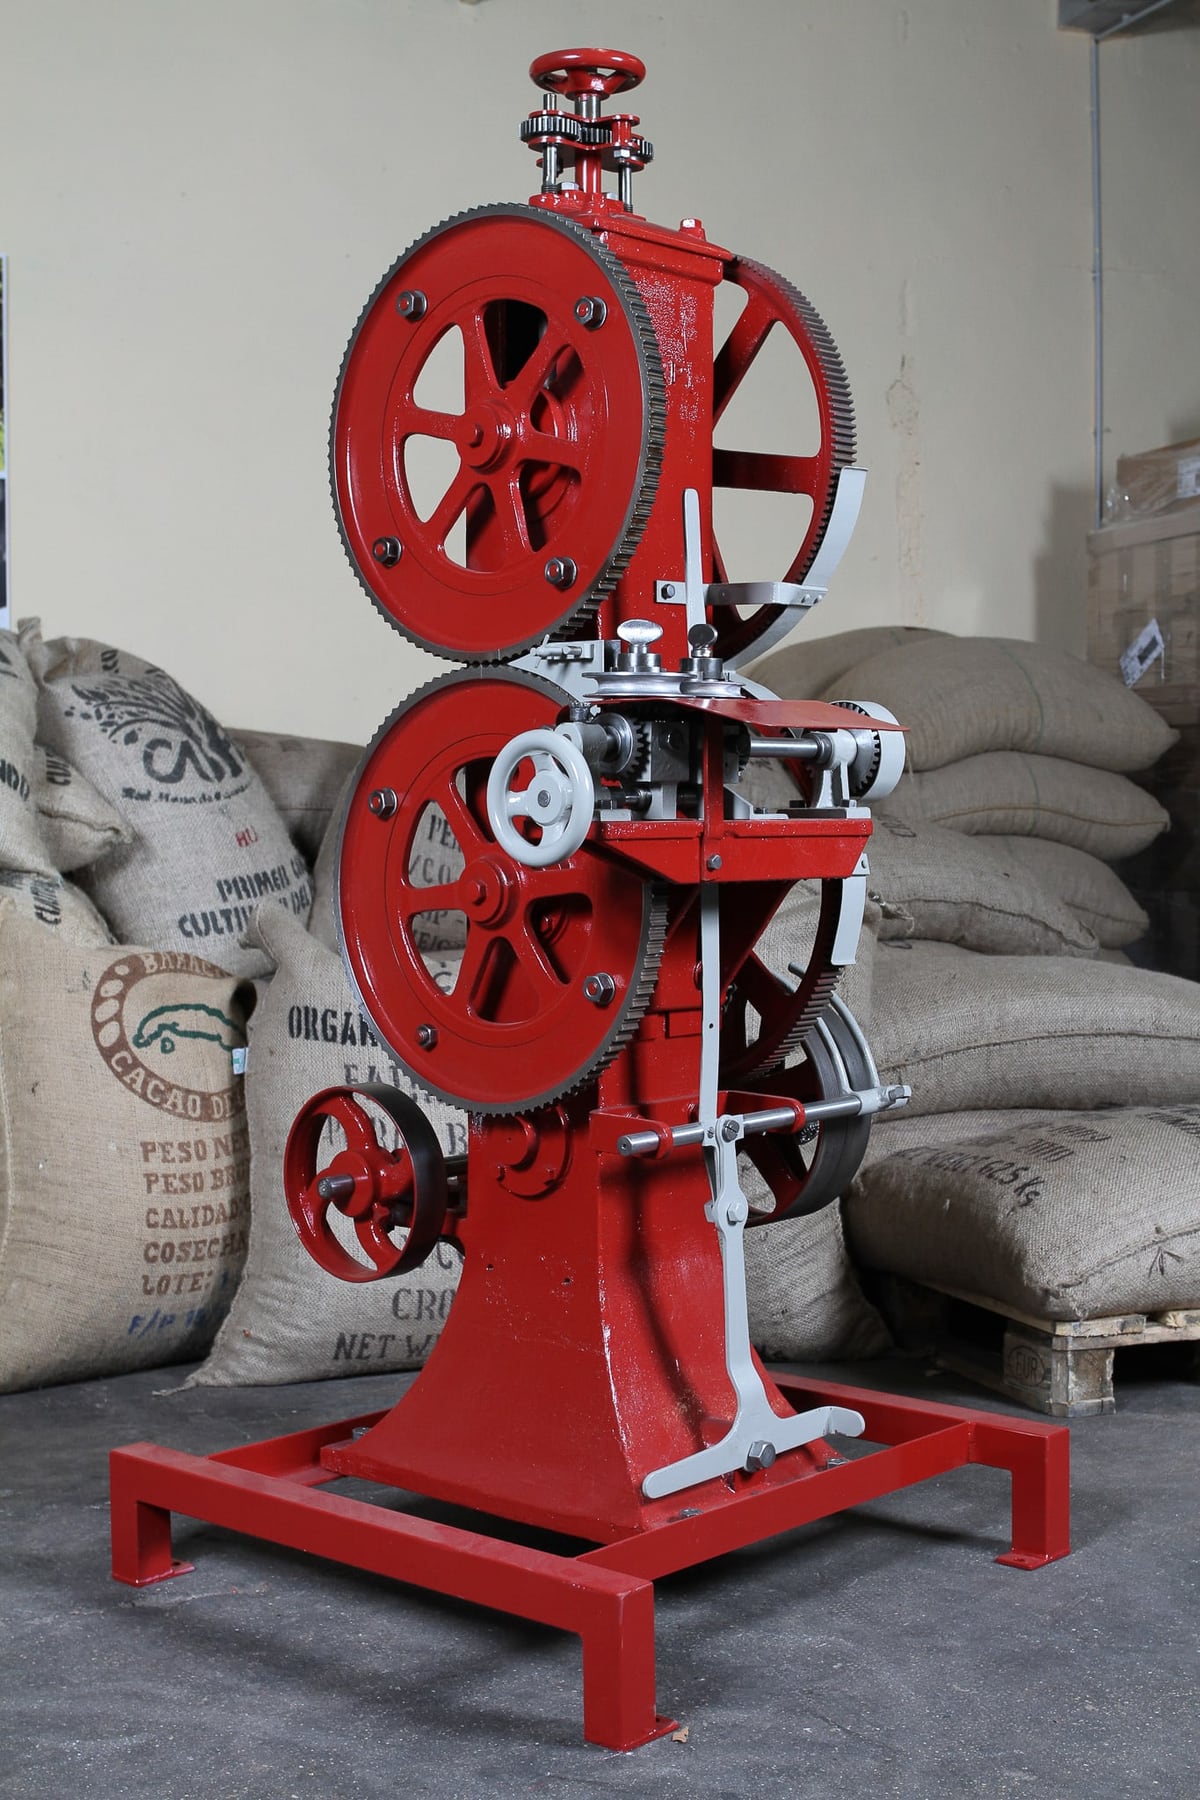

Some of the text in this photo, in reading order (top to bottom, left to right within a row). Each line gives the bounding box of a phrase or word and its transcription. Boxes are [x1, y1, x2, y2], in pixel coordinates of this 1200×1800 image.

[110, 1051, 202, 1119] CACAO
[139, 1138, 207, 1164] PESO
[143, 1170, 205, 1195] PESO
[333, 1332, 396, 1361] NET
[1015, 1351, 1039, 1383] EUR
